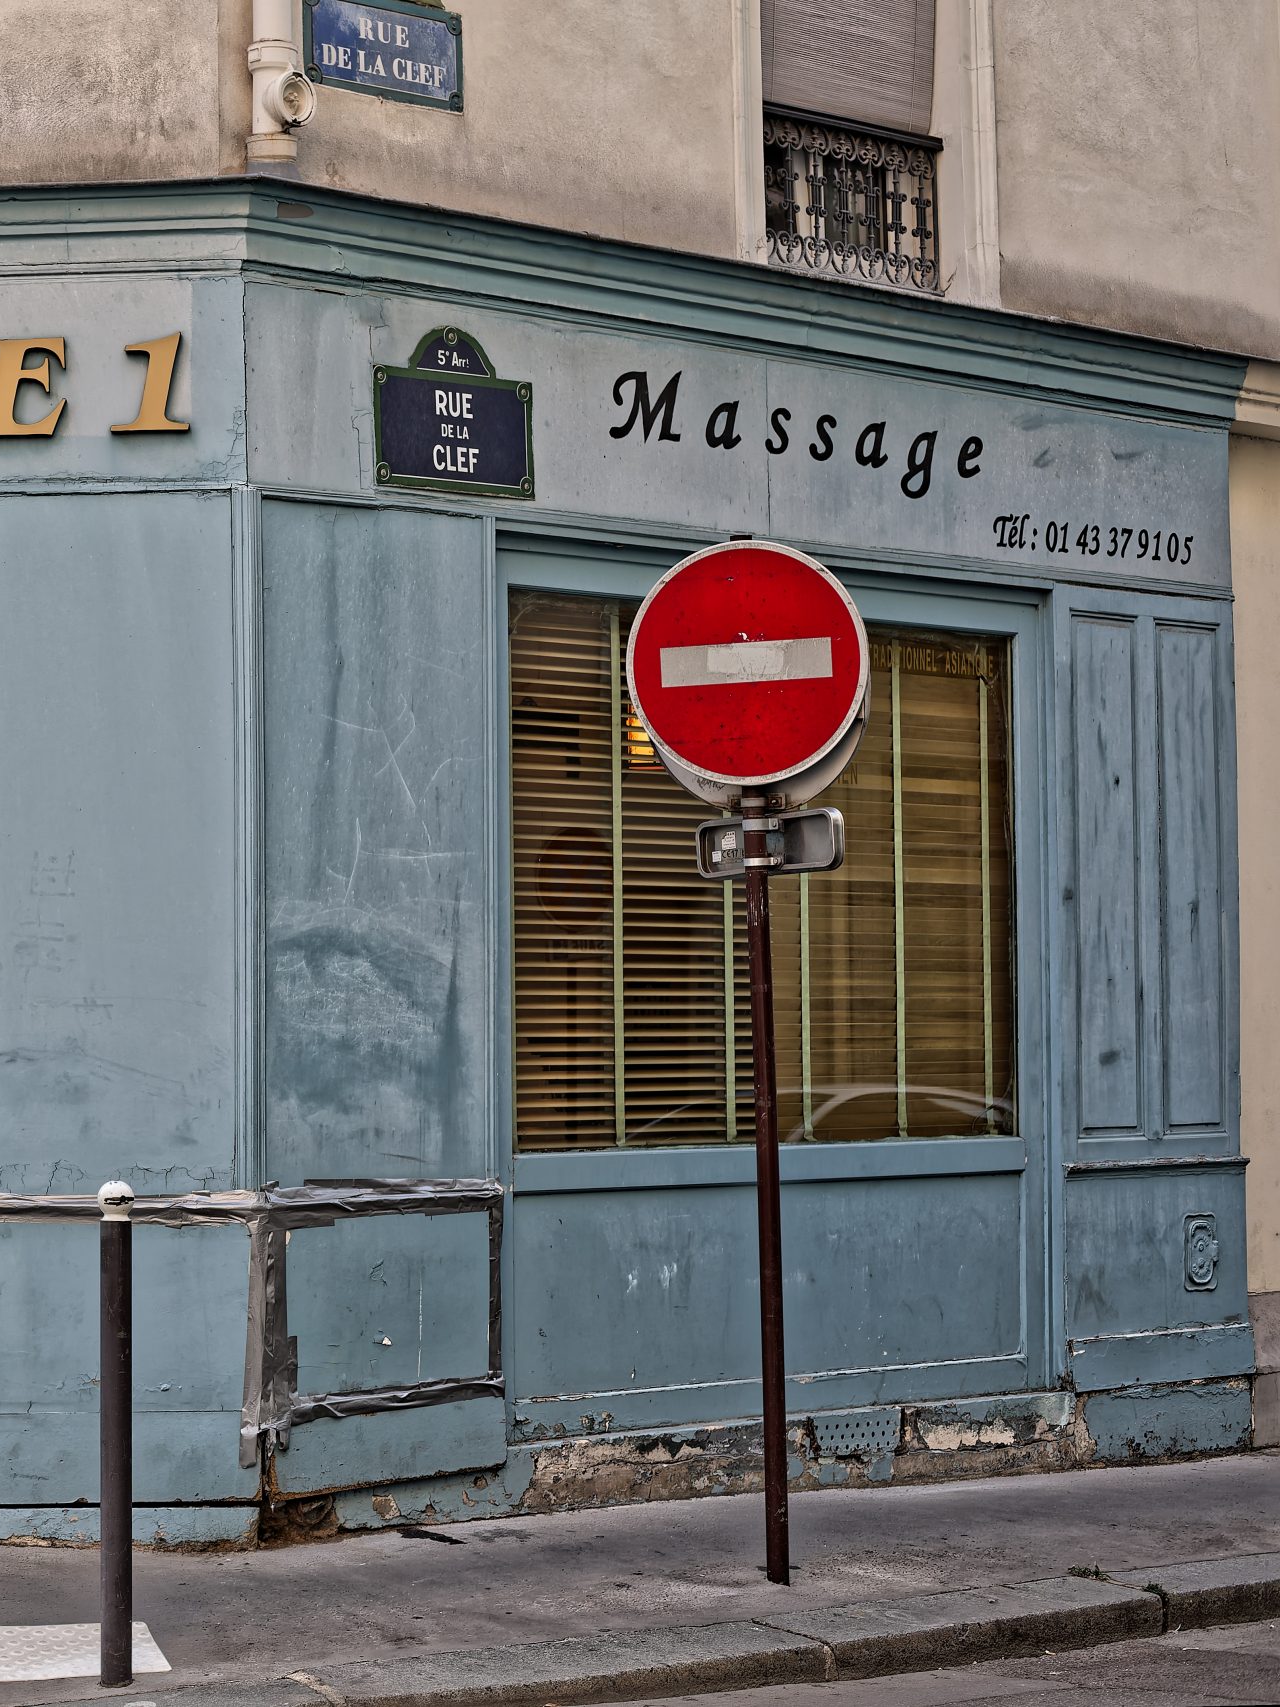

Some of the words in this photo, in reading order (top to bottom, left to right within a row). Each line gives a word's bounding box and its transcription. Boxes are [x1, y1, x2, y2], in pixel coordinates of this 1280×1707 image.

[358, 17, 410, 48] RUE
[321, 43, 351, 70] DE
[358, 50, 387, 77] LA
[392, 57, 447, 88] CLEF
[111, 333, 190, 434] 1
[435, 389, 474, 419] RUE
[441, 423, 454, 438] DE
[457, 425, 469, 440] LA
[608, 370, 985, 500] Massage
[432, 444, 480, 473] CLEF
[869, 643, 937, 672] RADTIONNEL
